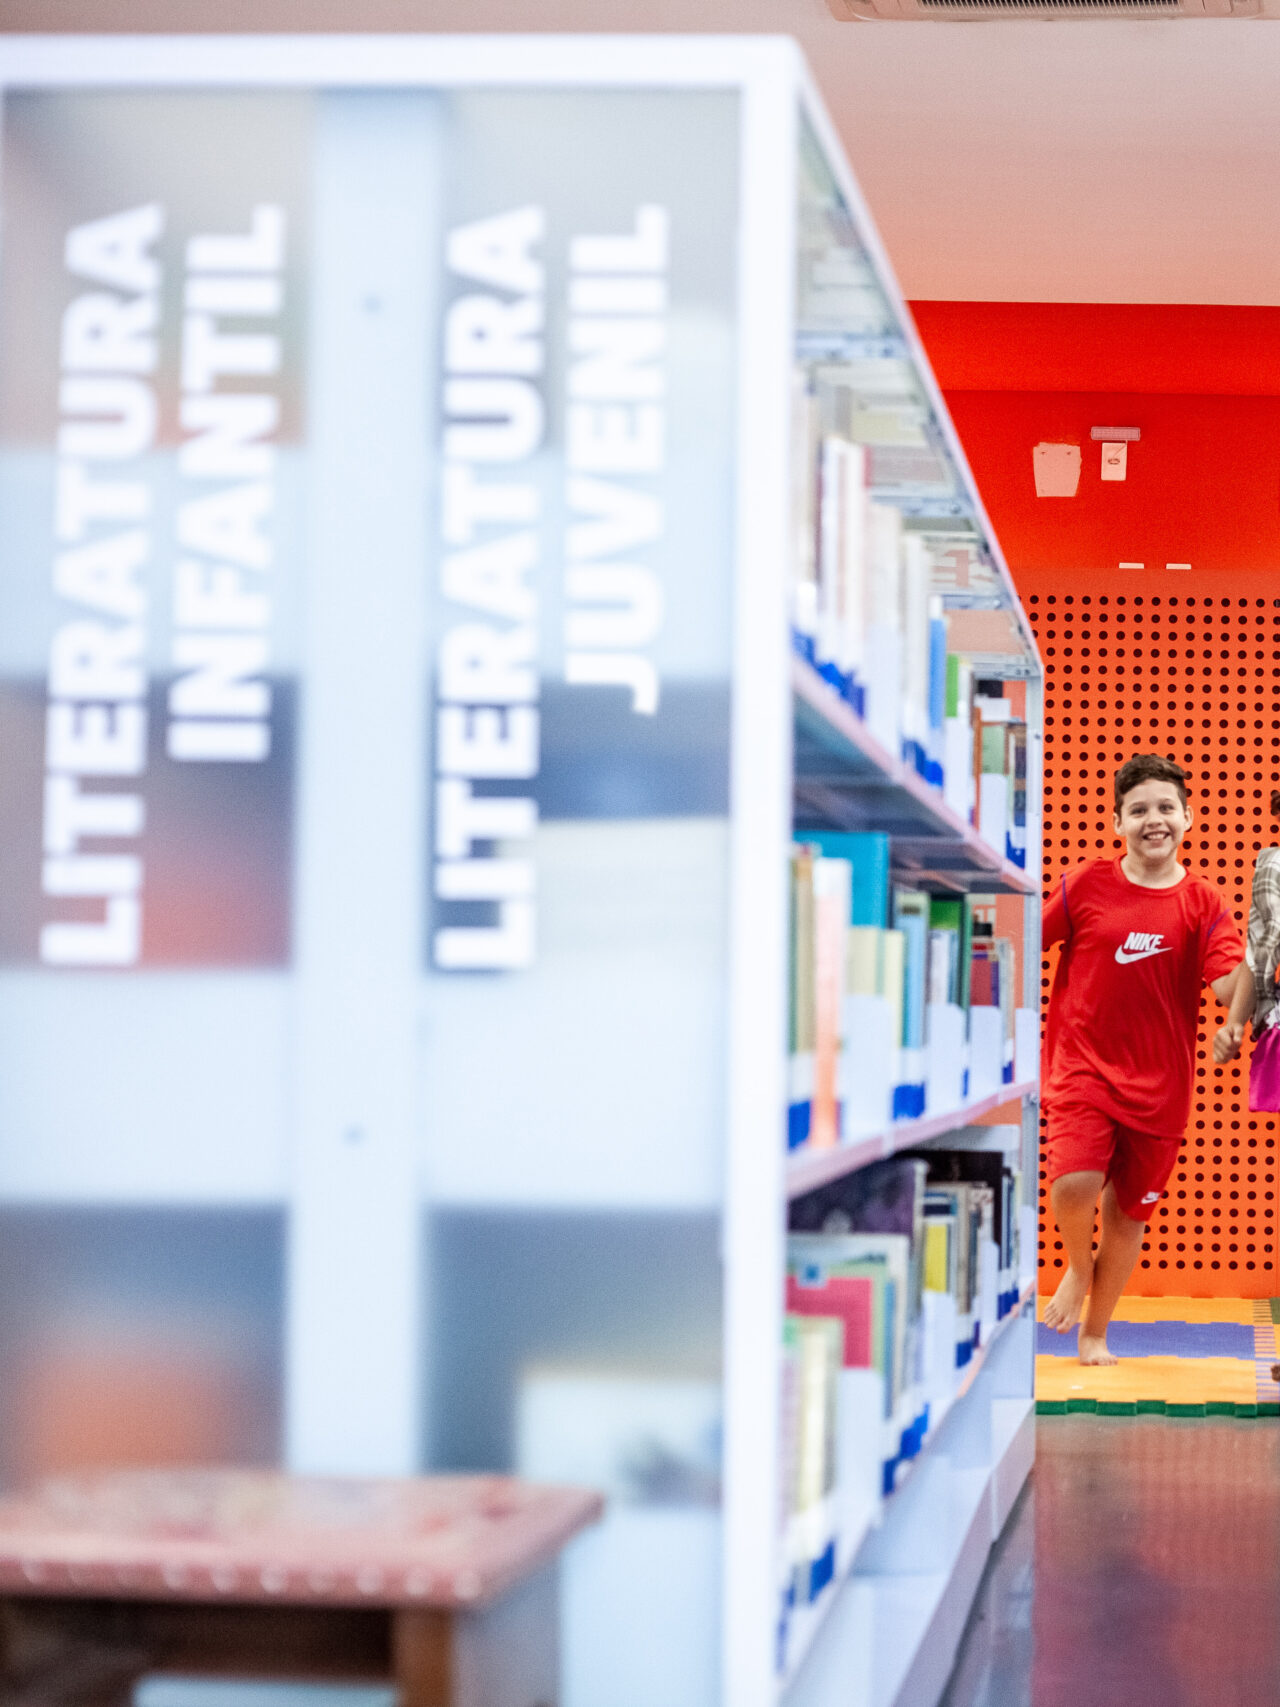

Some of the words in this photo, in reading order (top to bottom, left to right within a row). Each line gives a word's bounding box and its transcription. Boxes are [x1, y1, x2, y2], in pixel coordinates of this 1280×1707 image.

[40, 204, 164, 967] LITERATURA
[167, 203, 285, 761] INFANTIL
[434, 204, 546, 970] LITERATURA
[564, 203, 668, 715] JUVENIL
[1123, 931, 1165, 953] NIKE
